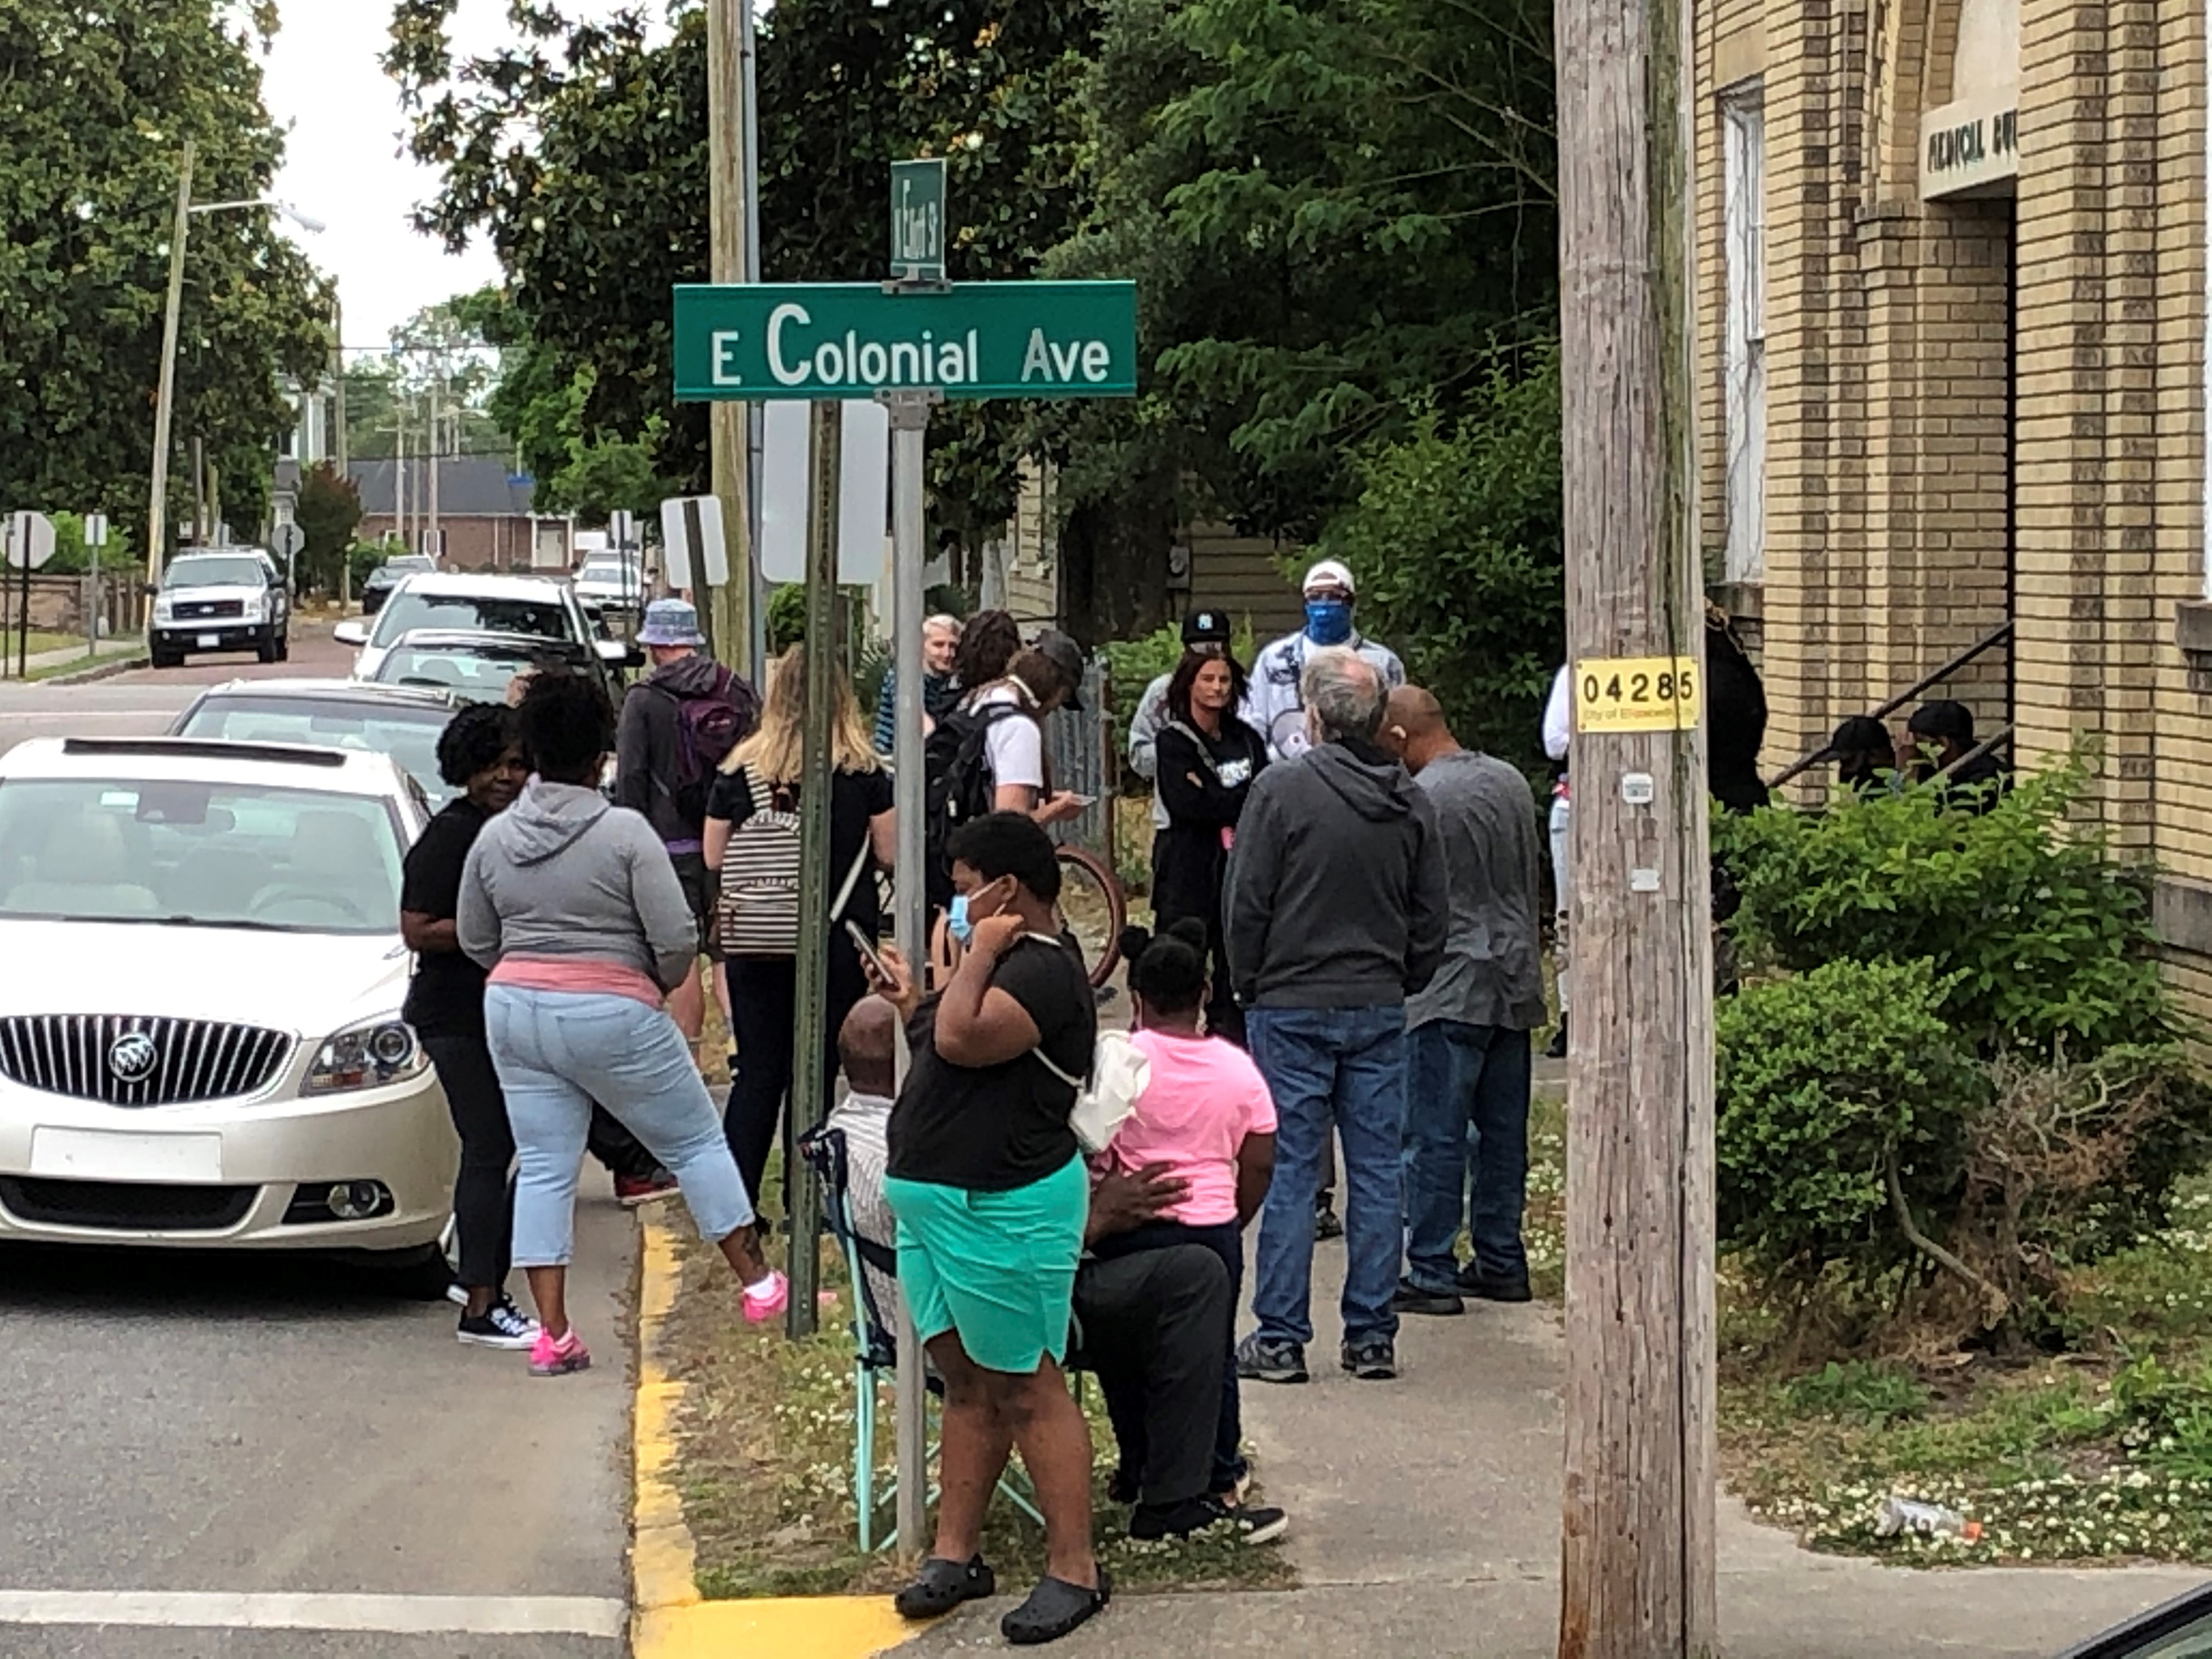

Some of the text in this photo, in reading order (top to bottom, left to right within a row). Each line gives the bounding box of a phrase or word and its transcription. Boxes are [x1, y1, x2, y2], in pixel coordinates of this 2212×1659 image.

[711, 302, 1110, 386] E Colonial Ave
[1583, 671, 1693, 704] 04285
